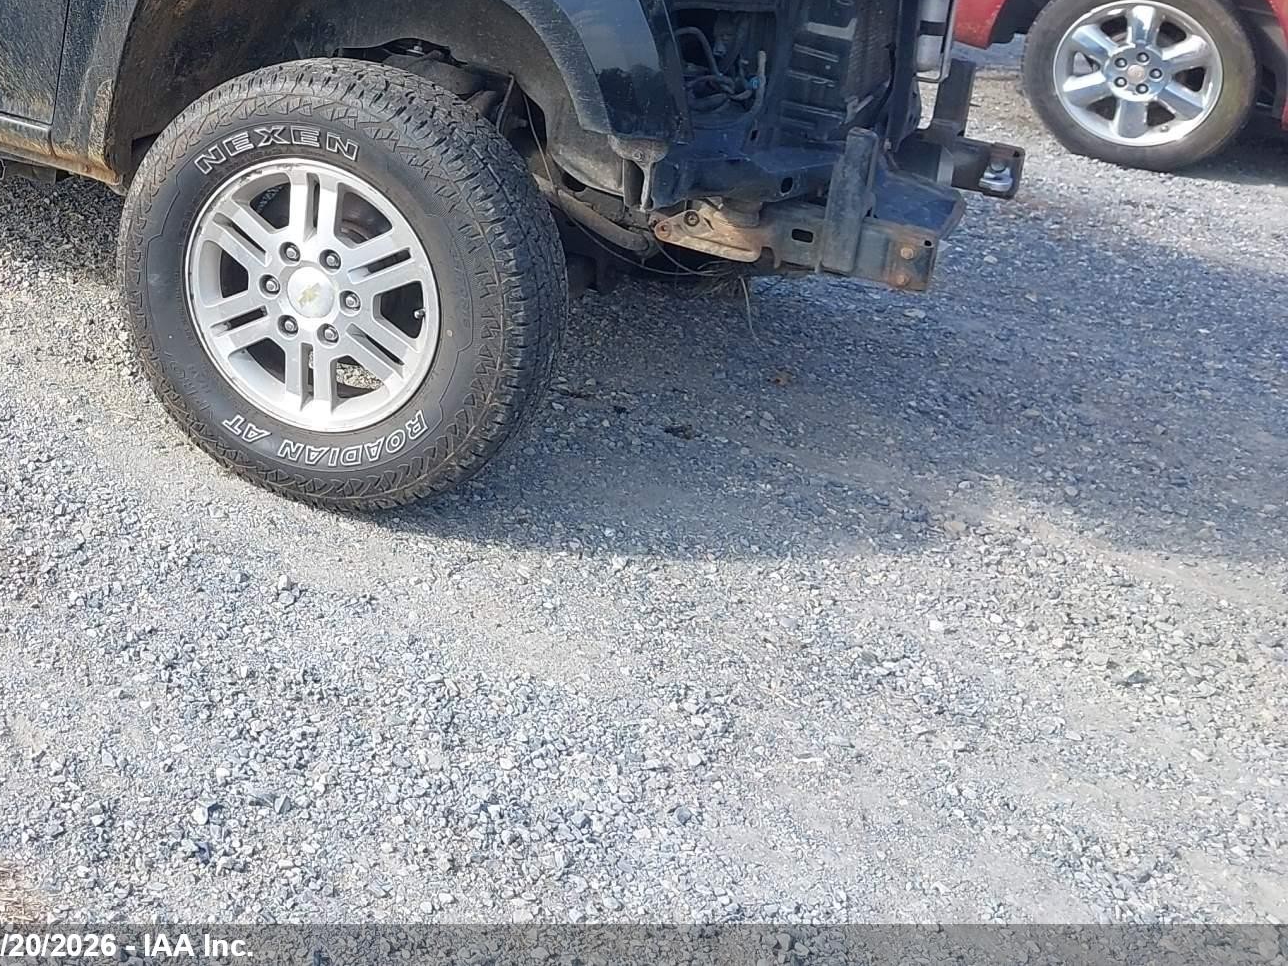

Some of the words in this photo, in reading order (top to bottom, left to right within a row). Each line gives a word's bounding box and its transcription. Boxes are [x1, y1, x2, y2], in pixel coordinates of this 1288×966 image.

[194, 124, 359, 175] NEXEN
[222, 414, 272, 443] AT
[277, 409, 429, 467] ROADIAN
